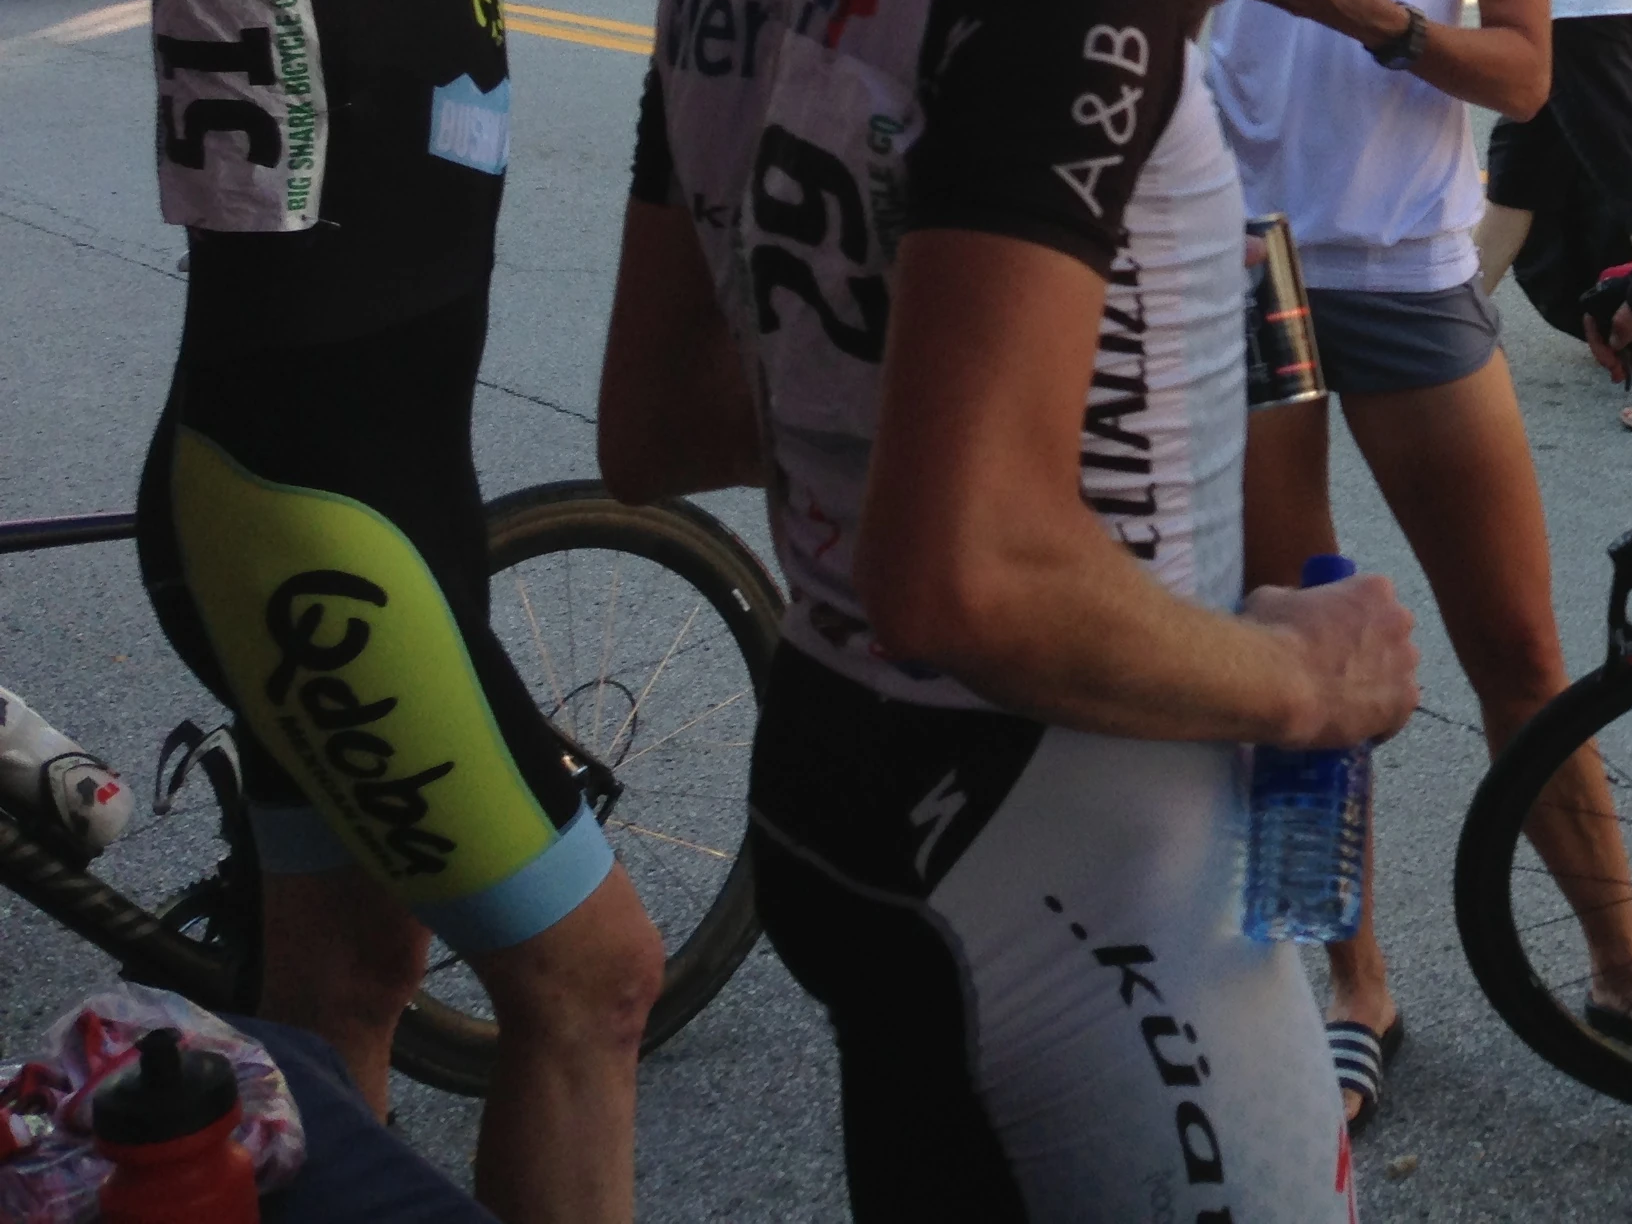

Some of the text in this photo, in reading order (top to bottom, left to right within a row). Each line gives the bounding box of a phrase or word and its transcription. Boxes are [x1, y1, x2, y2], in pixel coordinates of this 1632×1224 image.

[275, 12, 312, 96] BICYCLE
[1051, 23, 1151, 219] A&B
[286, 101, 315, 171] SHARK
[287, 176, 312, 212] BIG
[750, 122, 891, 364] 29
[266, 569, 458, 877] Qdoba
